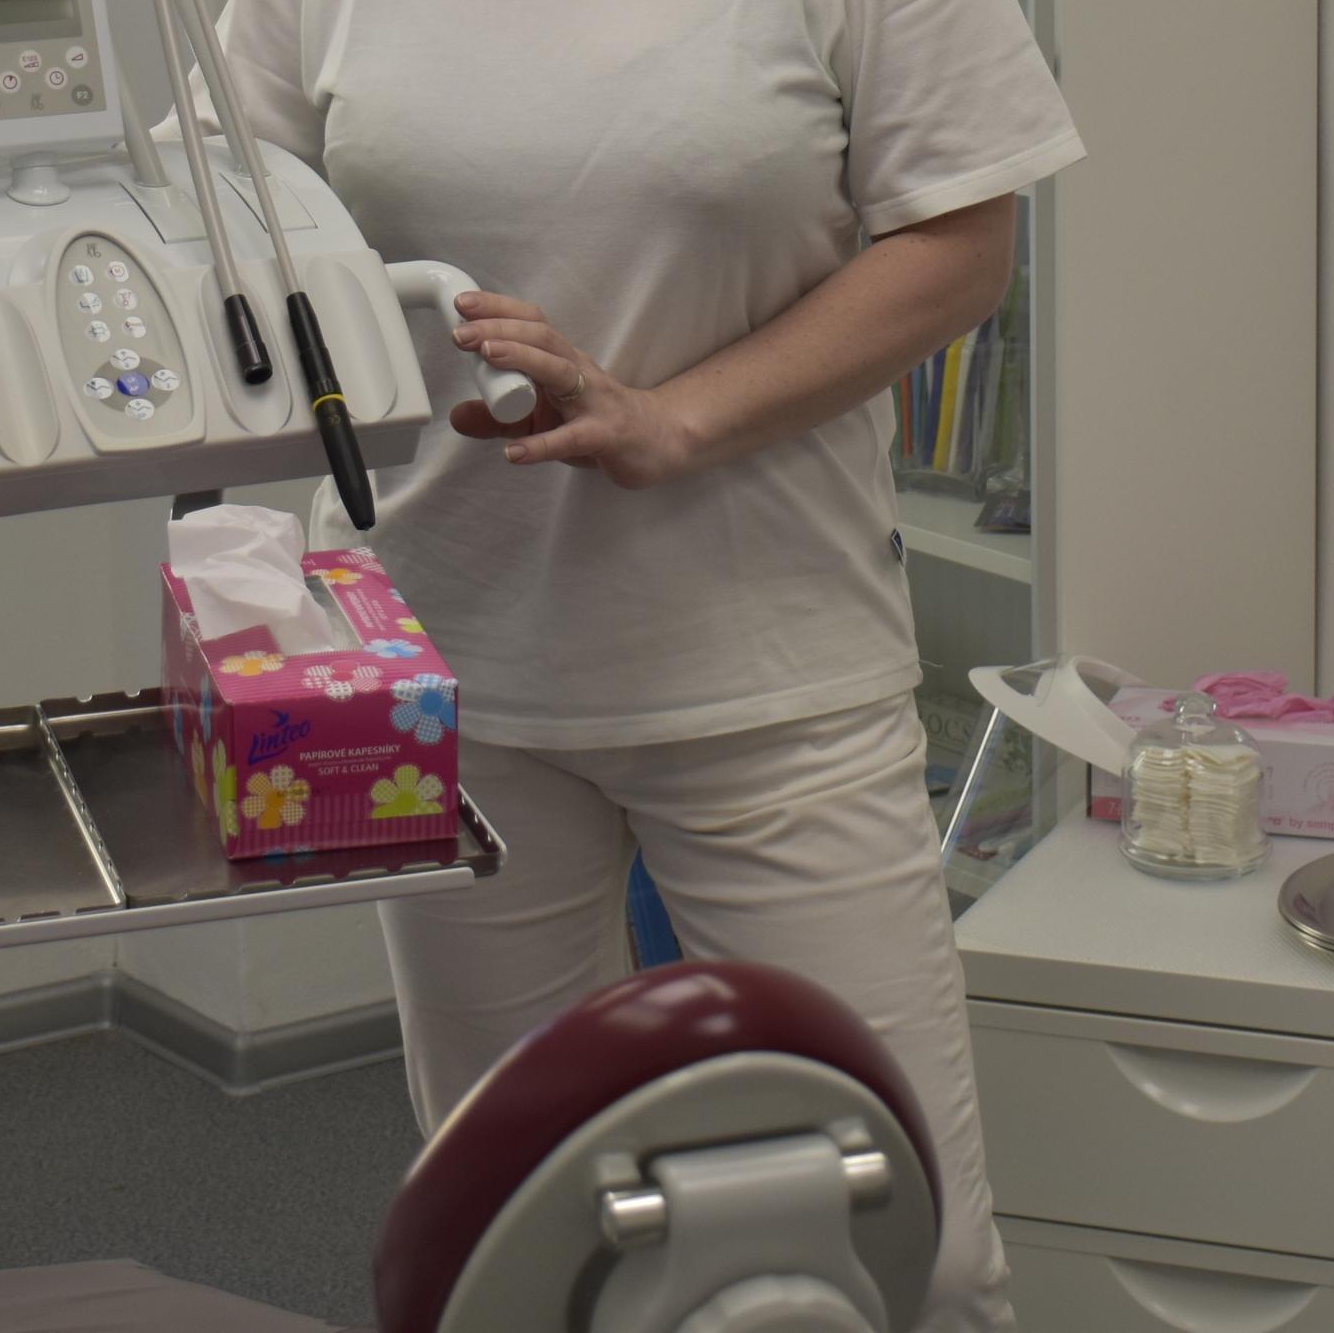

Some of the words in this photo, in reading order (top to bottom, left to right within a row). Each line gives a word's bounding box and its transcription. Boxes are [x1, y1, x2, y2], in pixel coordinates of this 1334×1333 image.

[76, 91, 88, 99] F2
[248, 720, 311, 765] Linteo
[299, 747, 346, 762] PAPÍROVÉ
[348, 744, 401, 757] KAPESNÍKY
[319, 766, 341, 776] SOFT
[351, 764, 379, 773] CLEAN
[1289, 817, 1303, 829] by
